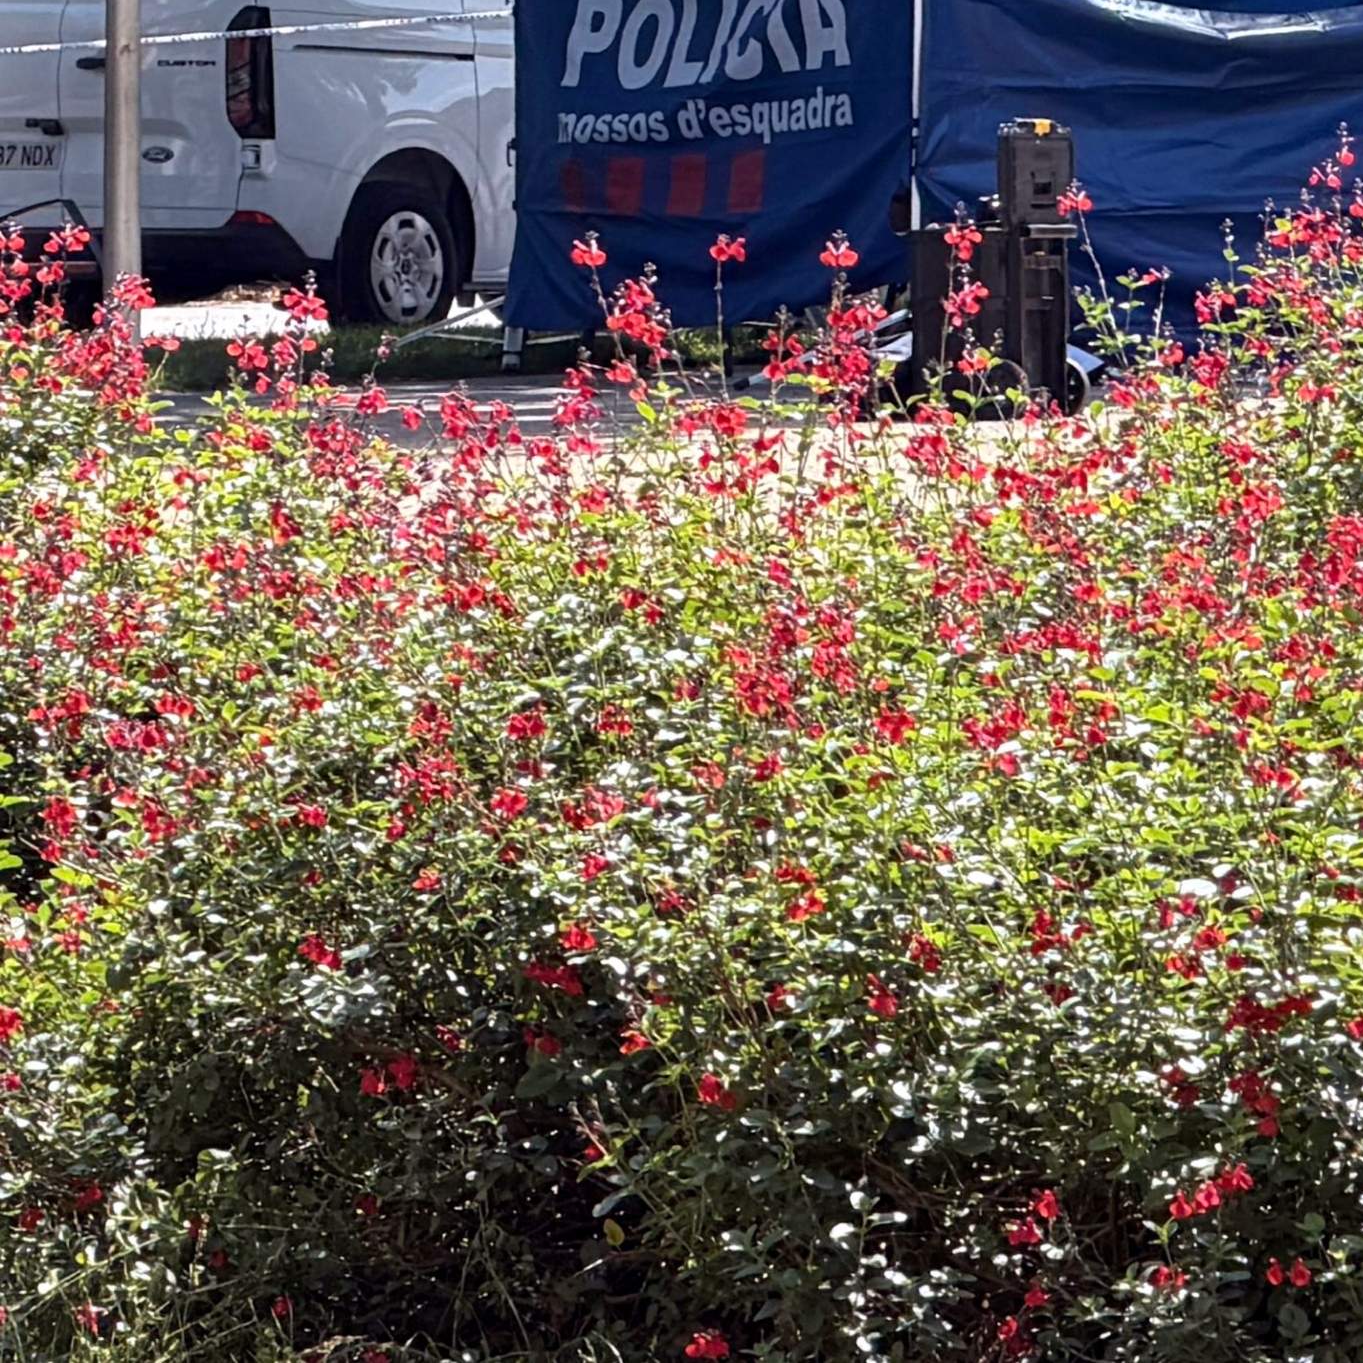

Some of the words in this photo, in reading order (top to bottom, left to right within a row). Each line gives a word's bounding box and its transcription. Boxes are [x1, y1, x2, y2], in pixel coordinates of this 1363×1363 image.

[157, 59, 216, 67] CUSTOM
[677, 86, 854, 145] d'esquadra
[21, 144, 56, 166] NDX
